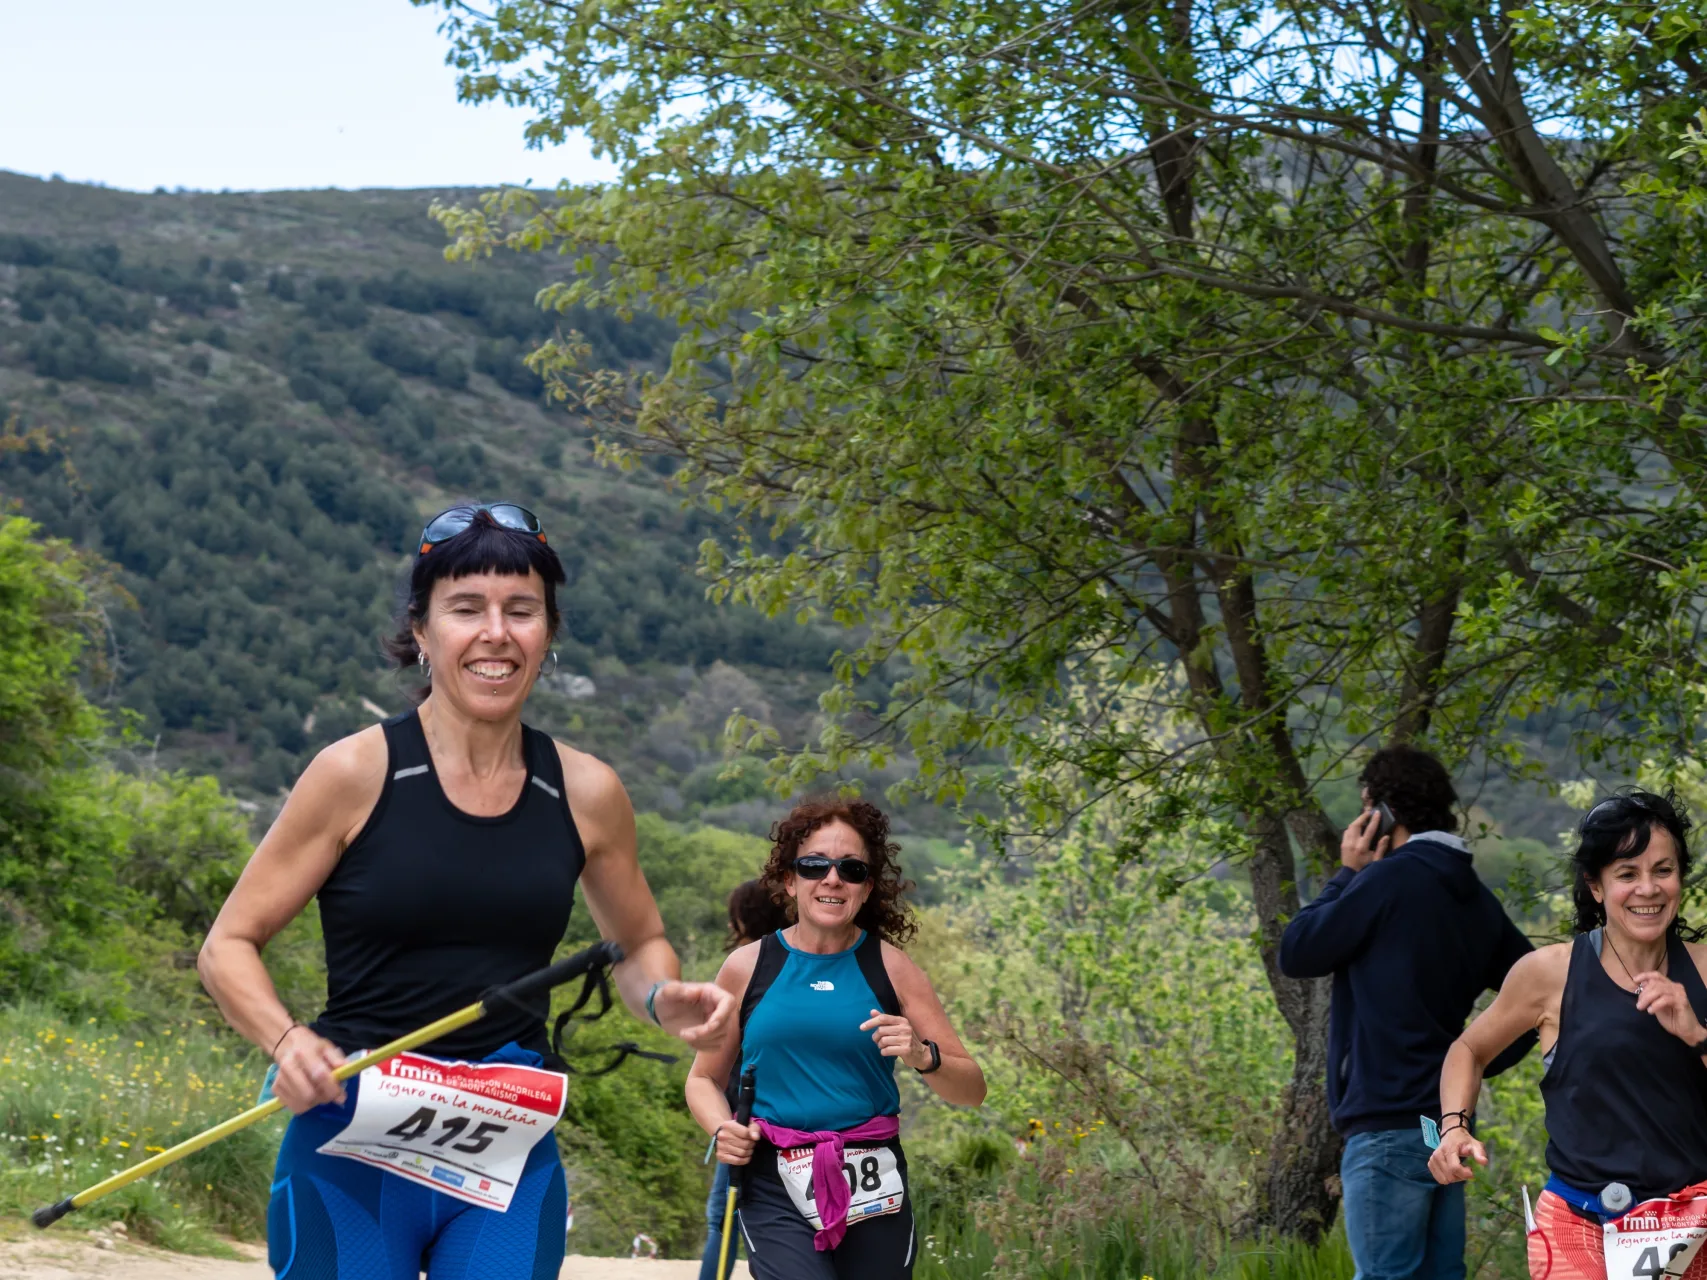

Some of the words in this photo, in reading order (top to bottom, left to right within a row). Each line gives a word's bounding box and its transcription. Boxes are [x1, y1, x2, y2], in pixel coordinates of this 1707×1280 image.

[390, 1059, 443, 1083] fmm
[502, 1082, 552, 1102] MADRILEÑA
[378, 1080, 426, 1098] seguro
[430, 1093, 449, 1105] en
[472, 1103, 538, 1126] montaña
[385, 1106, 509, 1154] 415
[788, 1160, 813, 1175] segur
[1623, 1210, 1660, 1231] fmm
[1616, 1236, 1651, 1249] seguro
